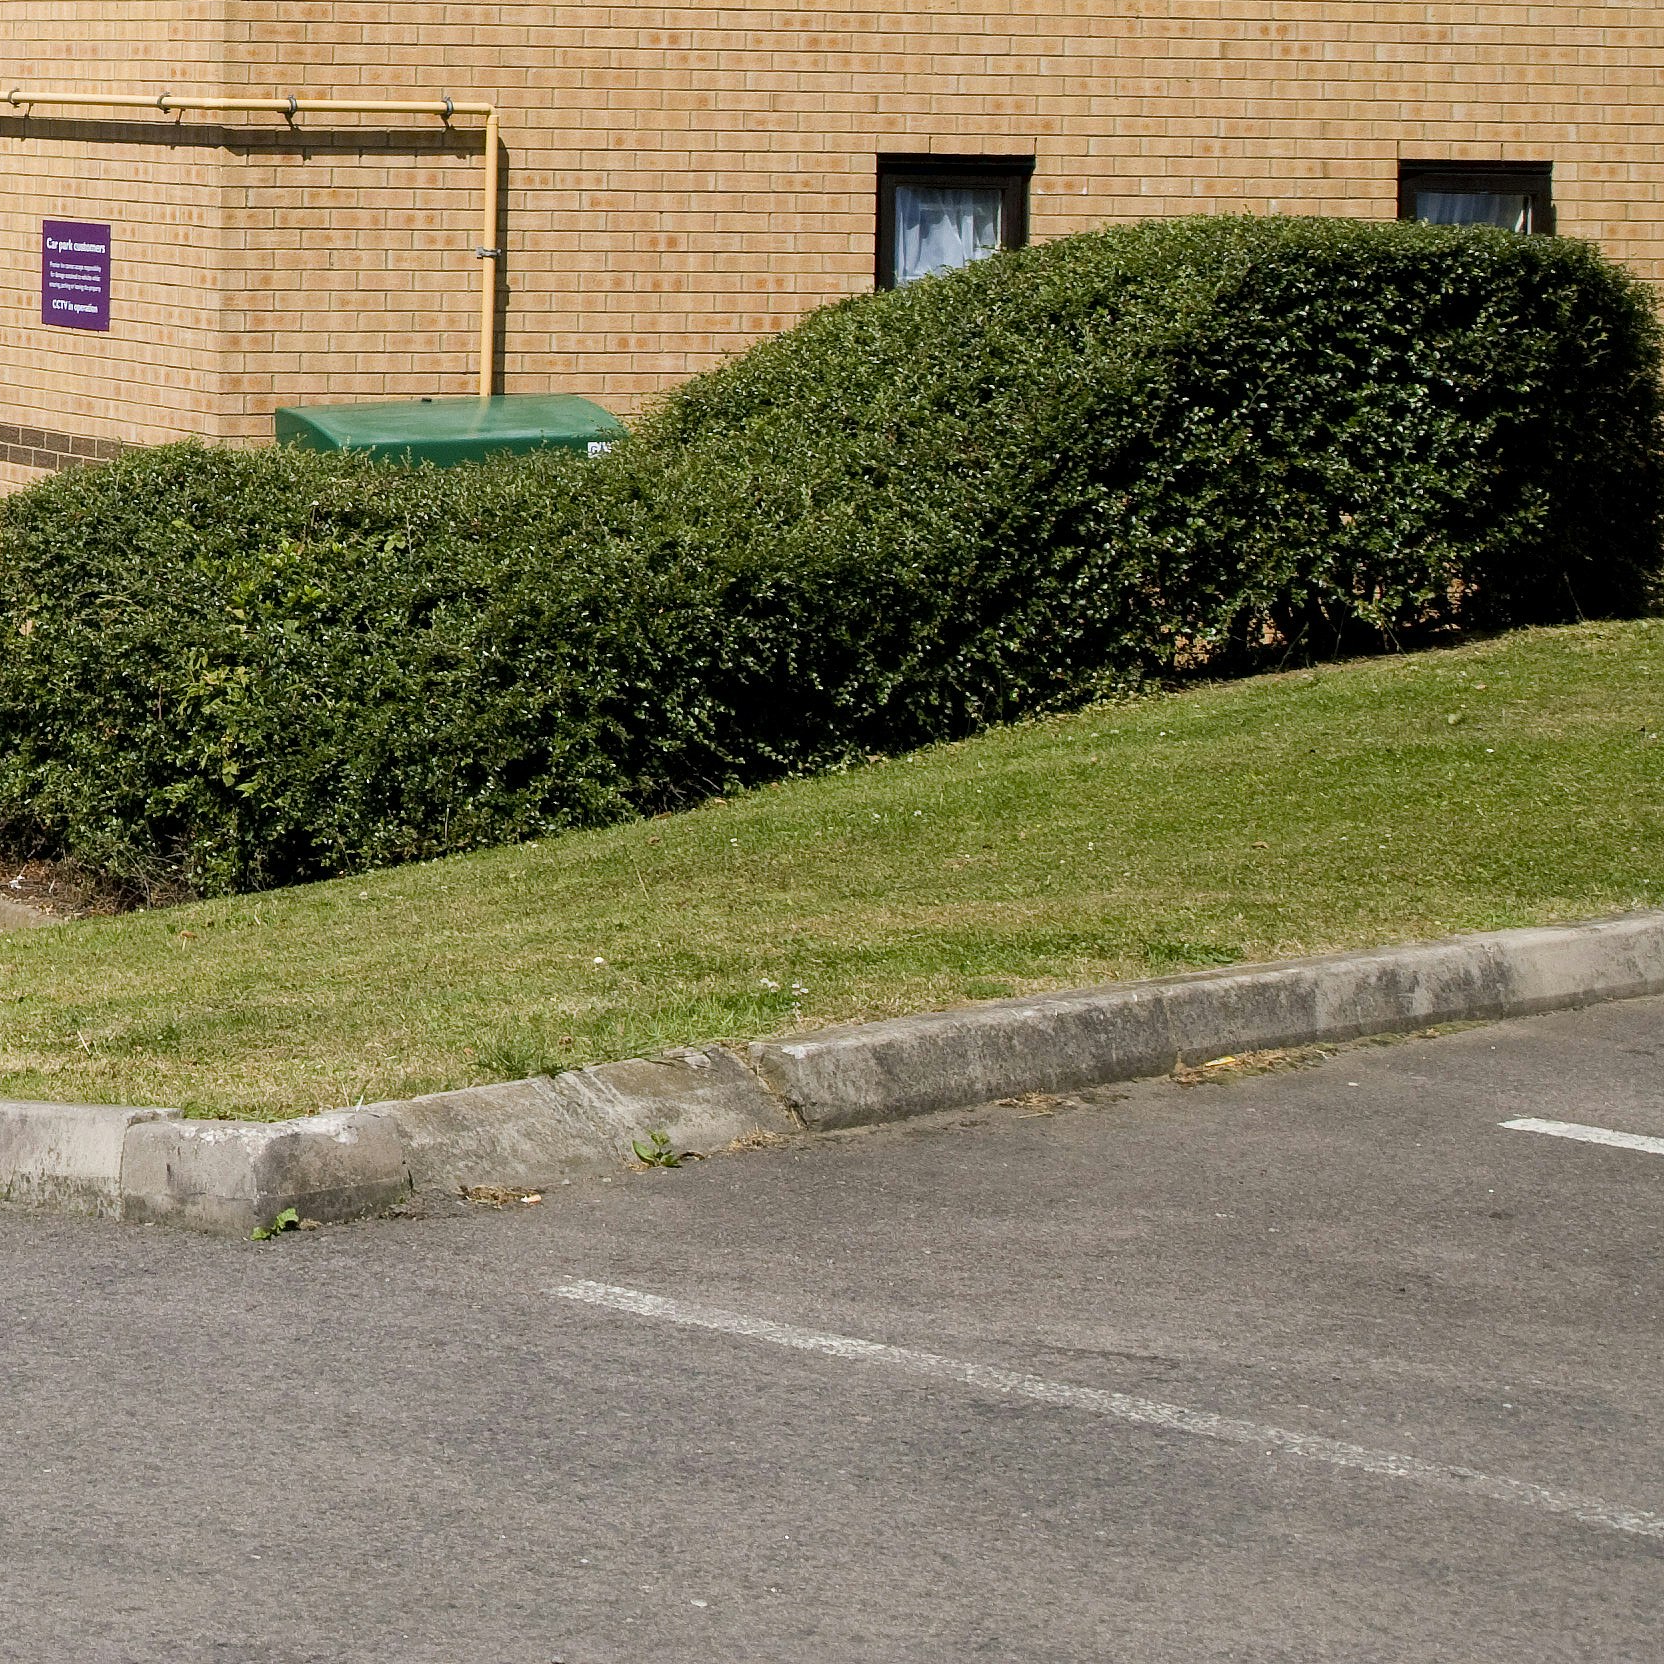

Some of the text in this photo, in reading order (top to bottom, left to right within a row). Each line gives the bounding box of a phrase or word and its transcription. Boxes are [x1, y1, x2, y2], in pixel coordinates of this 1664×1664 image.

[46, 237, 106, 253] Car park customers
[52, 299, 98, 314] CCTV in operation
